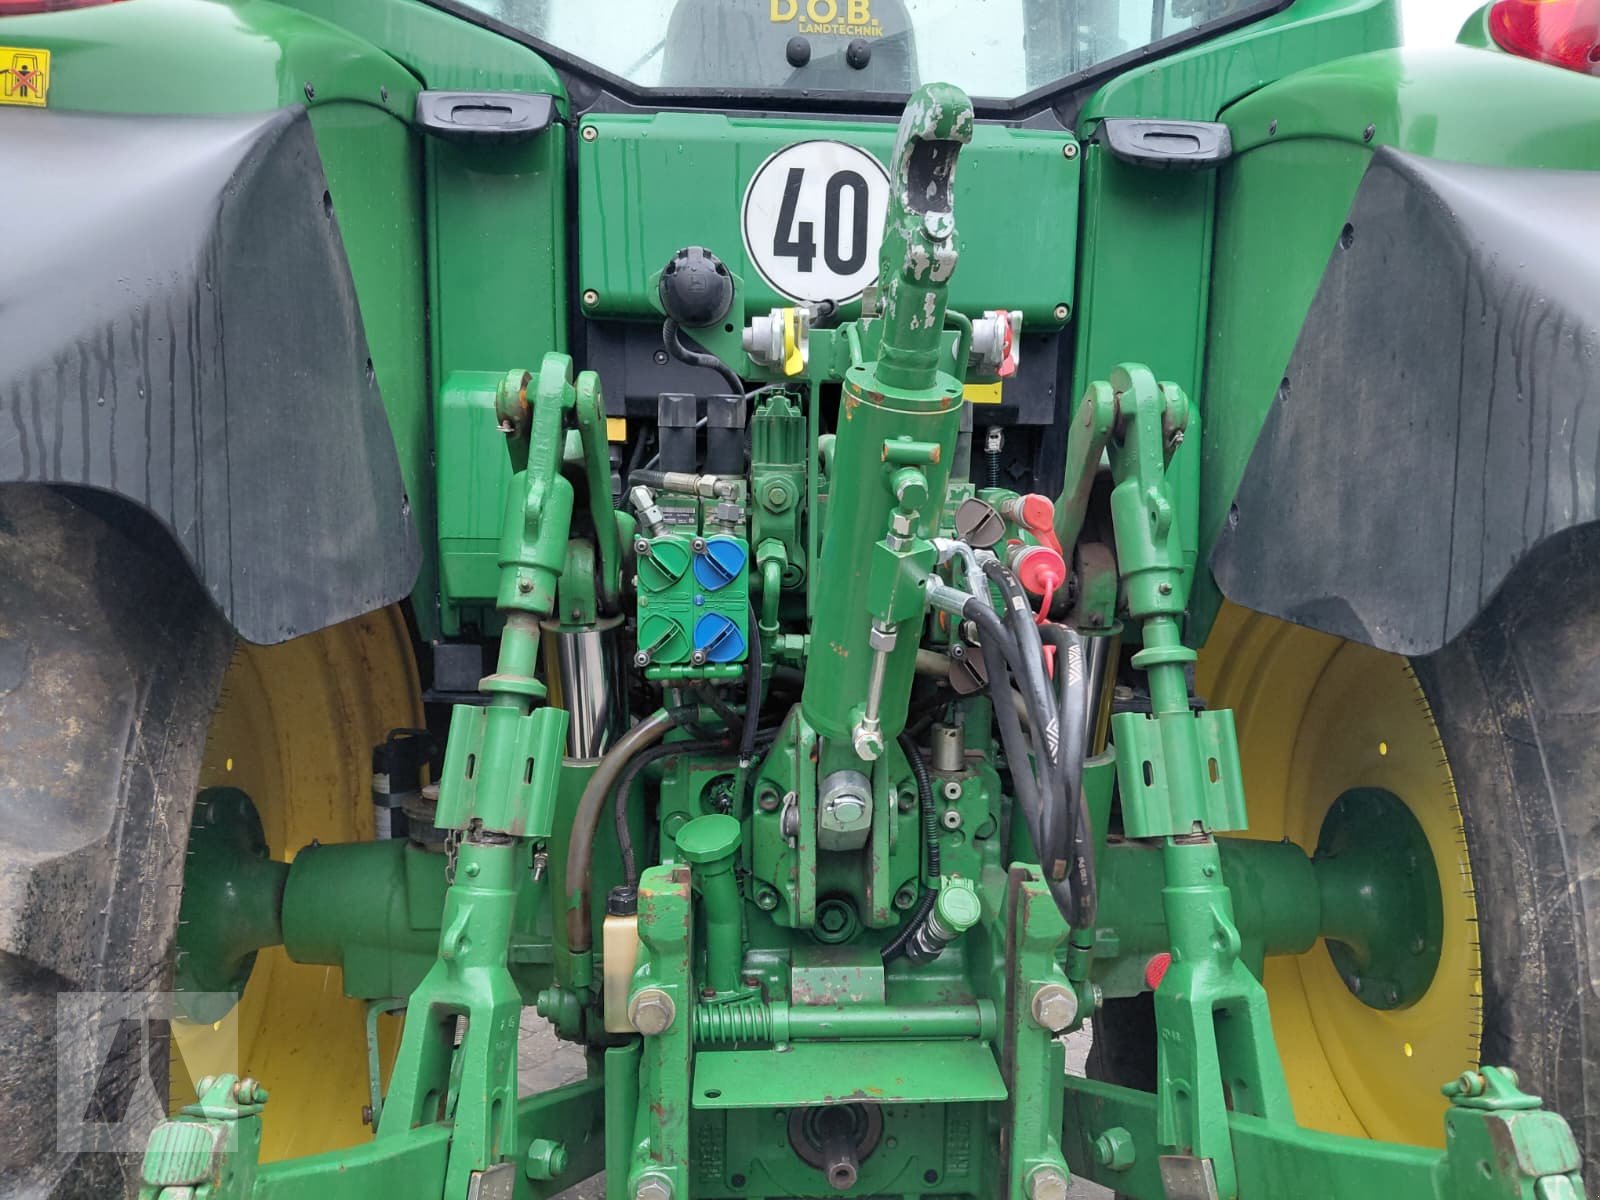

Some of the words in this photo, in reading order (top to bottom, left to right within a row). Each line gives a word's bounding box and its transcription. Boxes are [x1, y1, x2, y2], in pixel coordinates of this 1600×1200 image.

[770, 0, 879, 25] D.O.B.
[799, 23, 884, 37] LANDTECHNIK
[773, 167, 869, 276] 40
